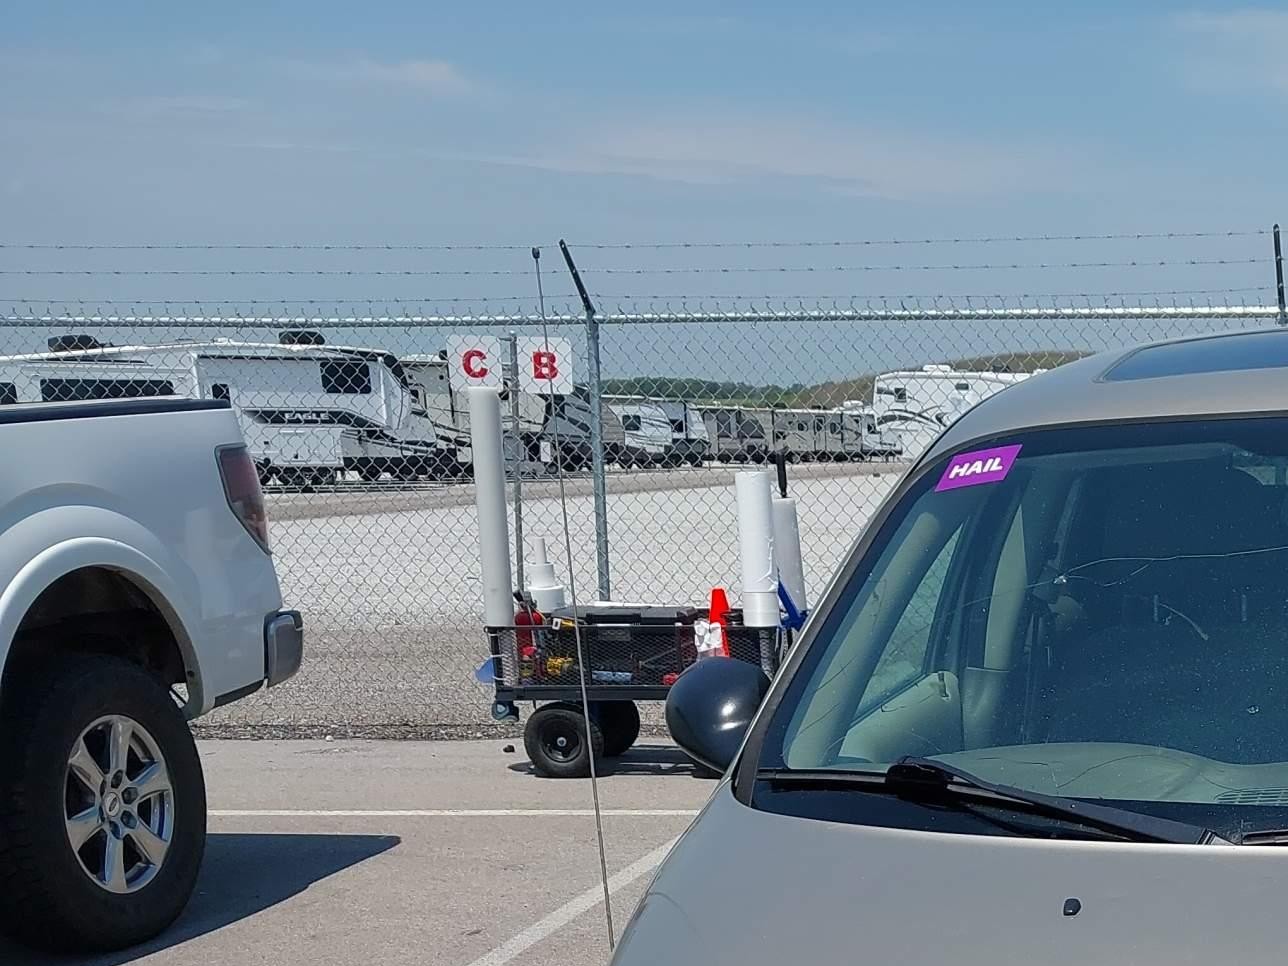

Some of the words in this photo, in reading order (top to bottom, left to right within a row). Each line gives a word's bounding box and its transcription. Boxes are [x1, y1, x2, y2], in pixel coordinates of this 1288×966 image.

[462, 350, 488, 378] C
[532, 351, 558, 379] B
[284, 412, 330, 420] EAGLE
[948, 457, 1004, 479] HAIL
